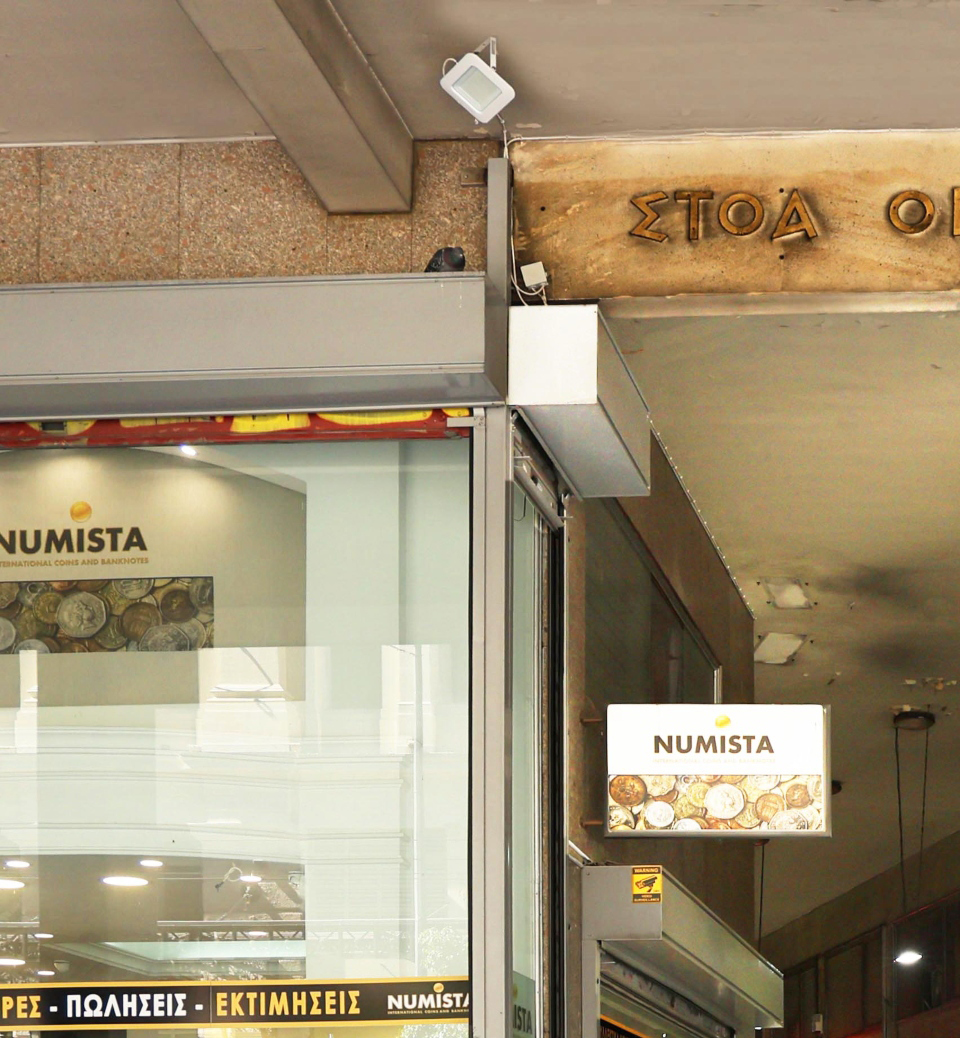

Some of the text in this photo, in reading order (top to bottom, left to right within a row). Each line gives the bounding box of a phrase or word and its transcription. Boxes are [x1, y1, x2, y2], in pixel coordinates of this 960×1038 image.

[629, 188, 818, 243] ΣΤΟΑ
[54, 559, 79, 567] COINS
[81, 558, 99, 566] AND
[101, 557, 149, 566] BANKNOTES
[653, 734, 775, 754] NUMISTA
[66, 993, 187, 1018] ΠΩΛΗΣΕΙΣ
[216, 989, 360, 1016] ΕΚΤΙΜΗΣΕΙΣ
[513, 1004, 533, 1035] ISTA
